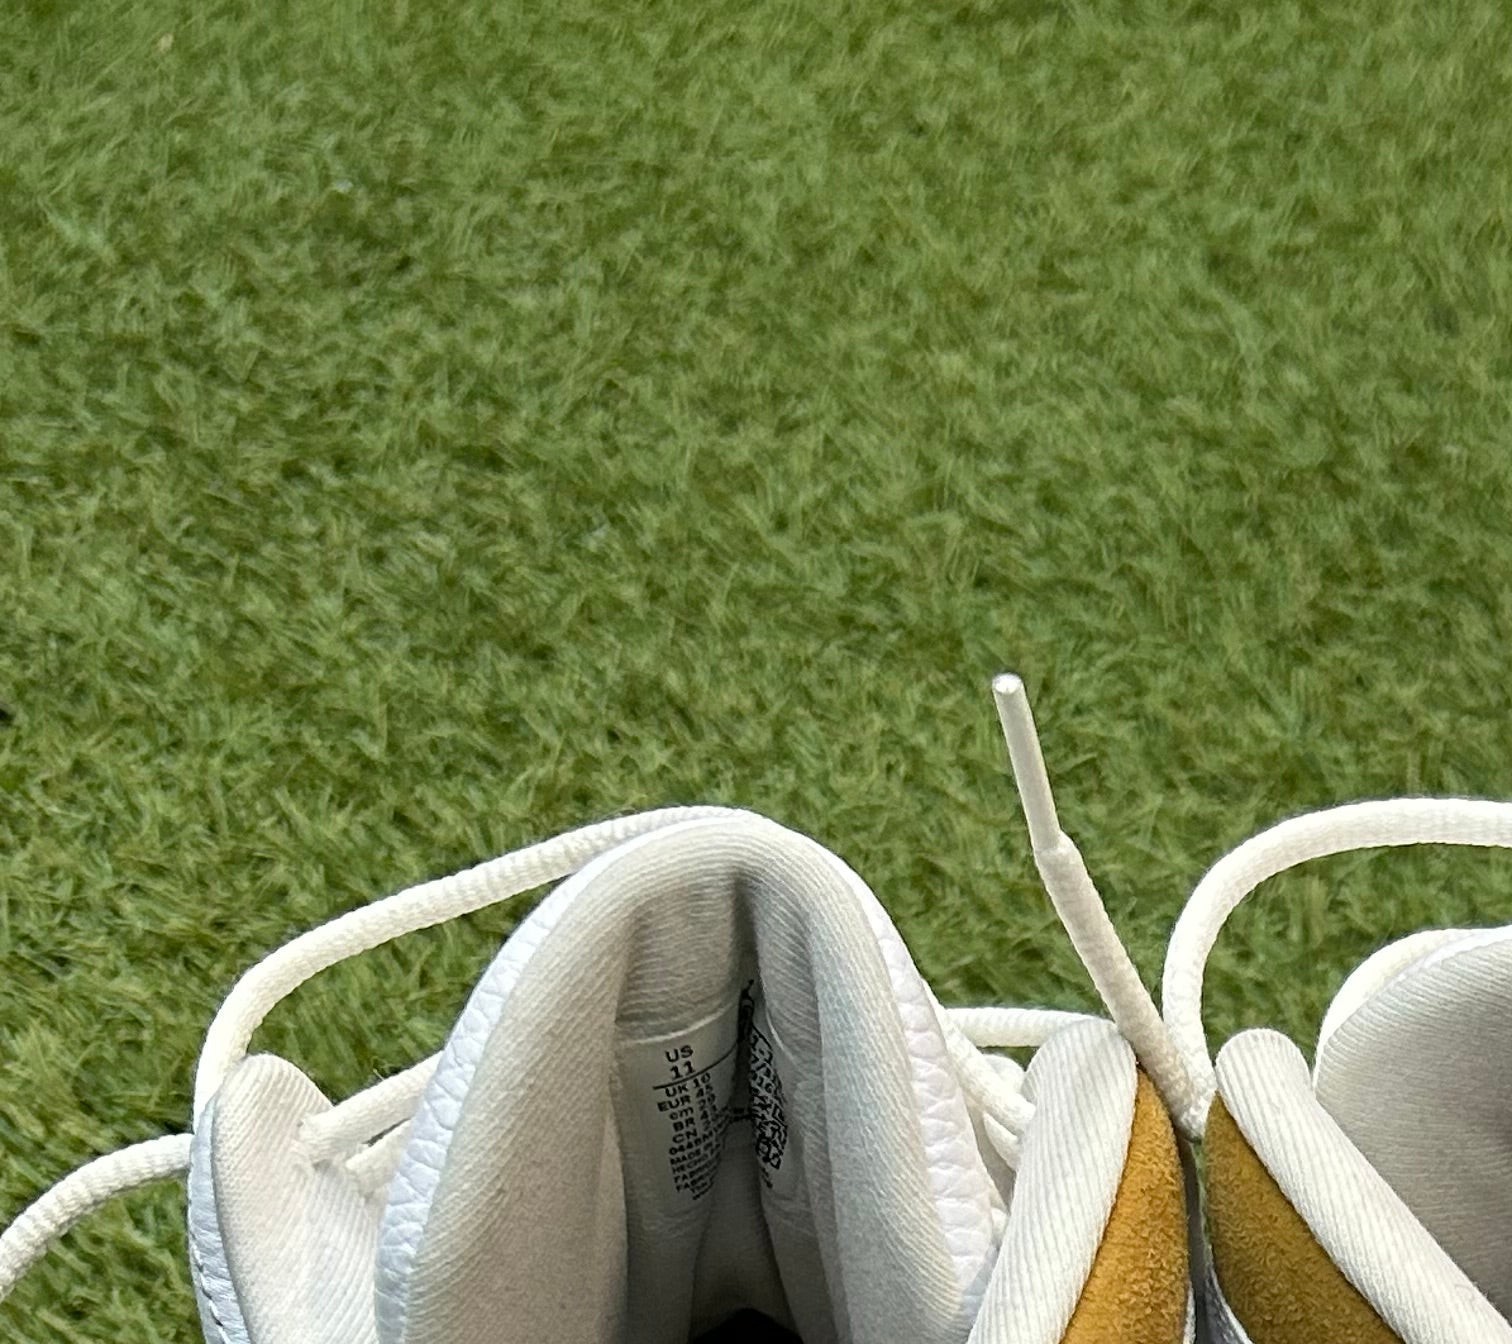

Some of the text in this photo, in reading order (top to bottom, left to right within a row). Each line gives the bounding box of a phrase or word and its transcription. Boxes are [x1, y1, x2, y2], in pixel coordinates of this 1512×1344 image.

[665, 1045, 694, 1063] US
[671, 1062, 696, 1081] 11
[665, 1073, 711, 1098] UK 10
[657, 1094, 691, 1112] EUR
[669, 1106, 694, 1121] cm
[673, 1118, 696, 1133] BR
[672, 1129, 698, 1144] CN
